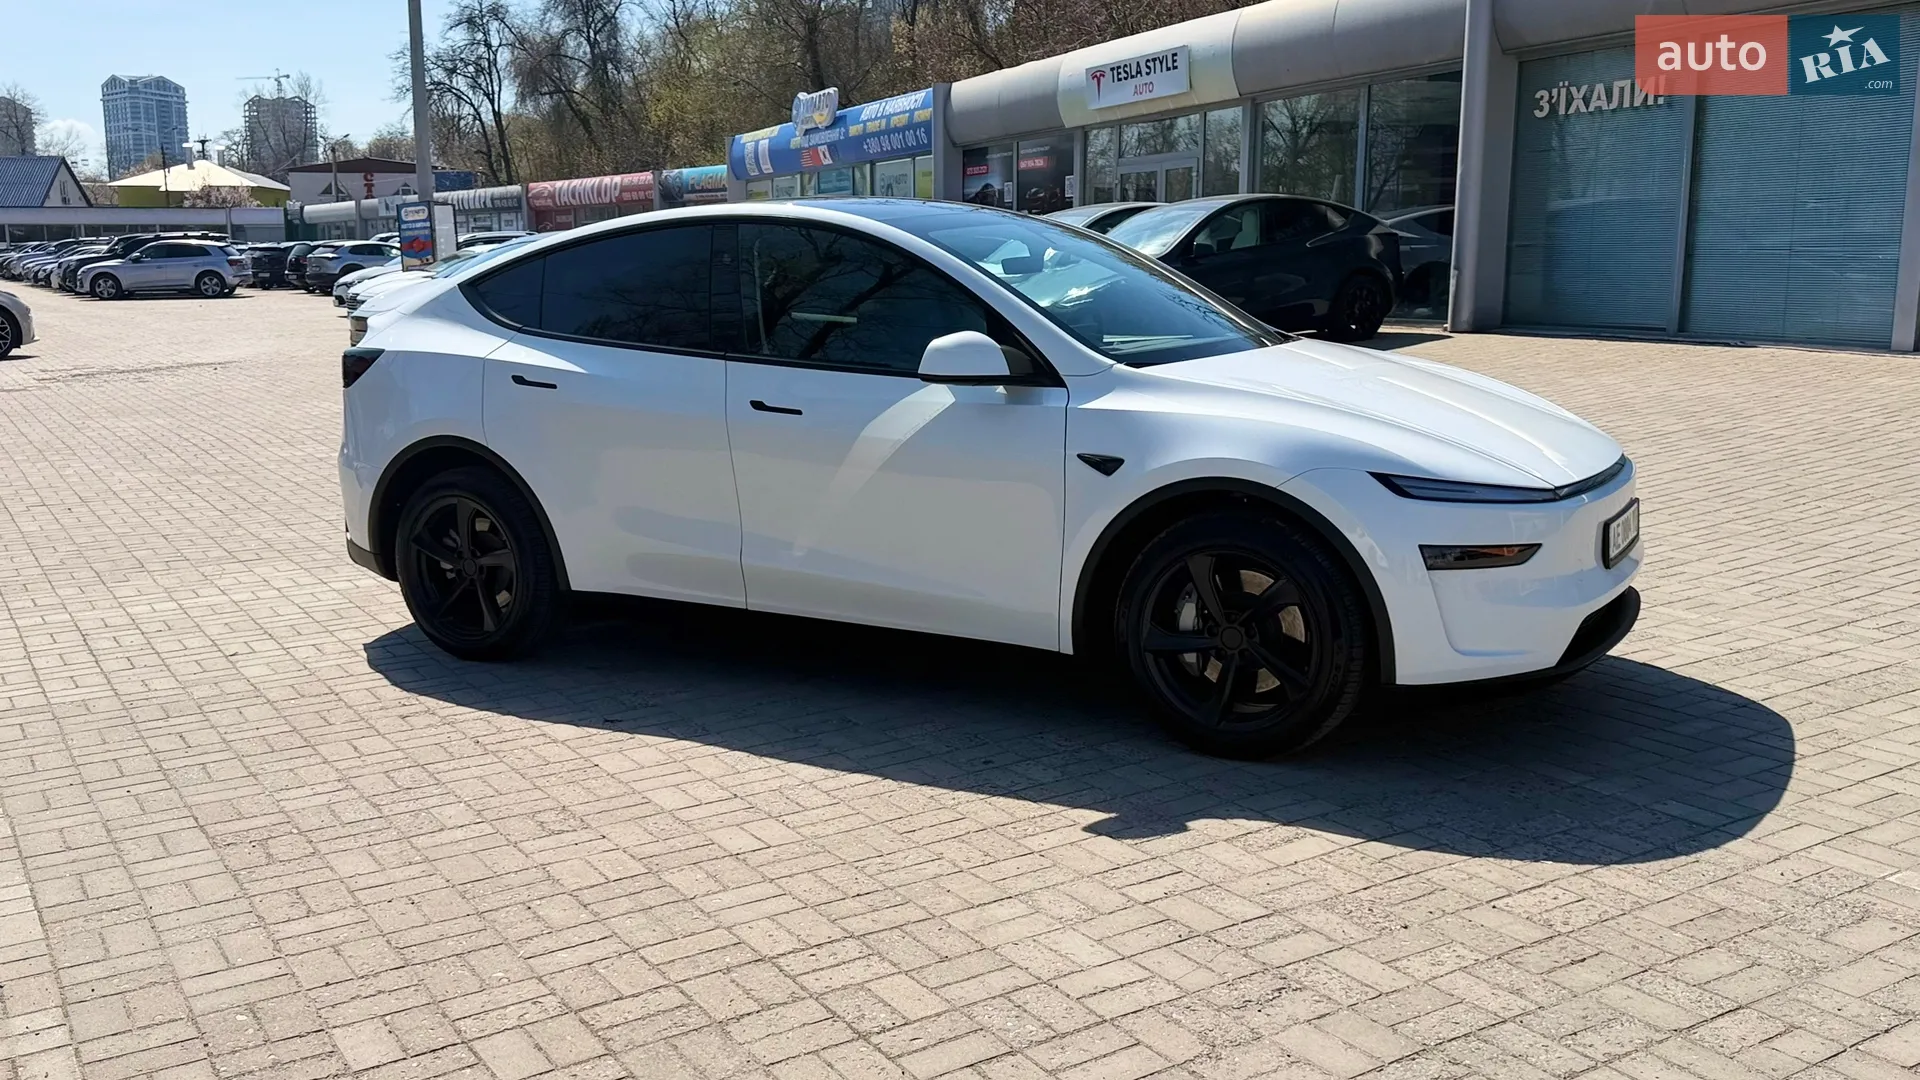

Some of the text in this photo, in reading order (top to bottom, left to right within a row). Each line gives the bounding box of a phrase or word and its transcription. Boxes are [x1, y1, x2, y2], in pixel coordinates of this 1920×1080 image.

[1109, 52, 1179, 83] TESLA STYLE
[1132, 81, 1155, 97] AUTO
[863, 127, 928, 154] +380 98 001 00 16
[554, 175, 621, 206] TACHKI.DP
